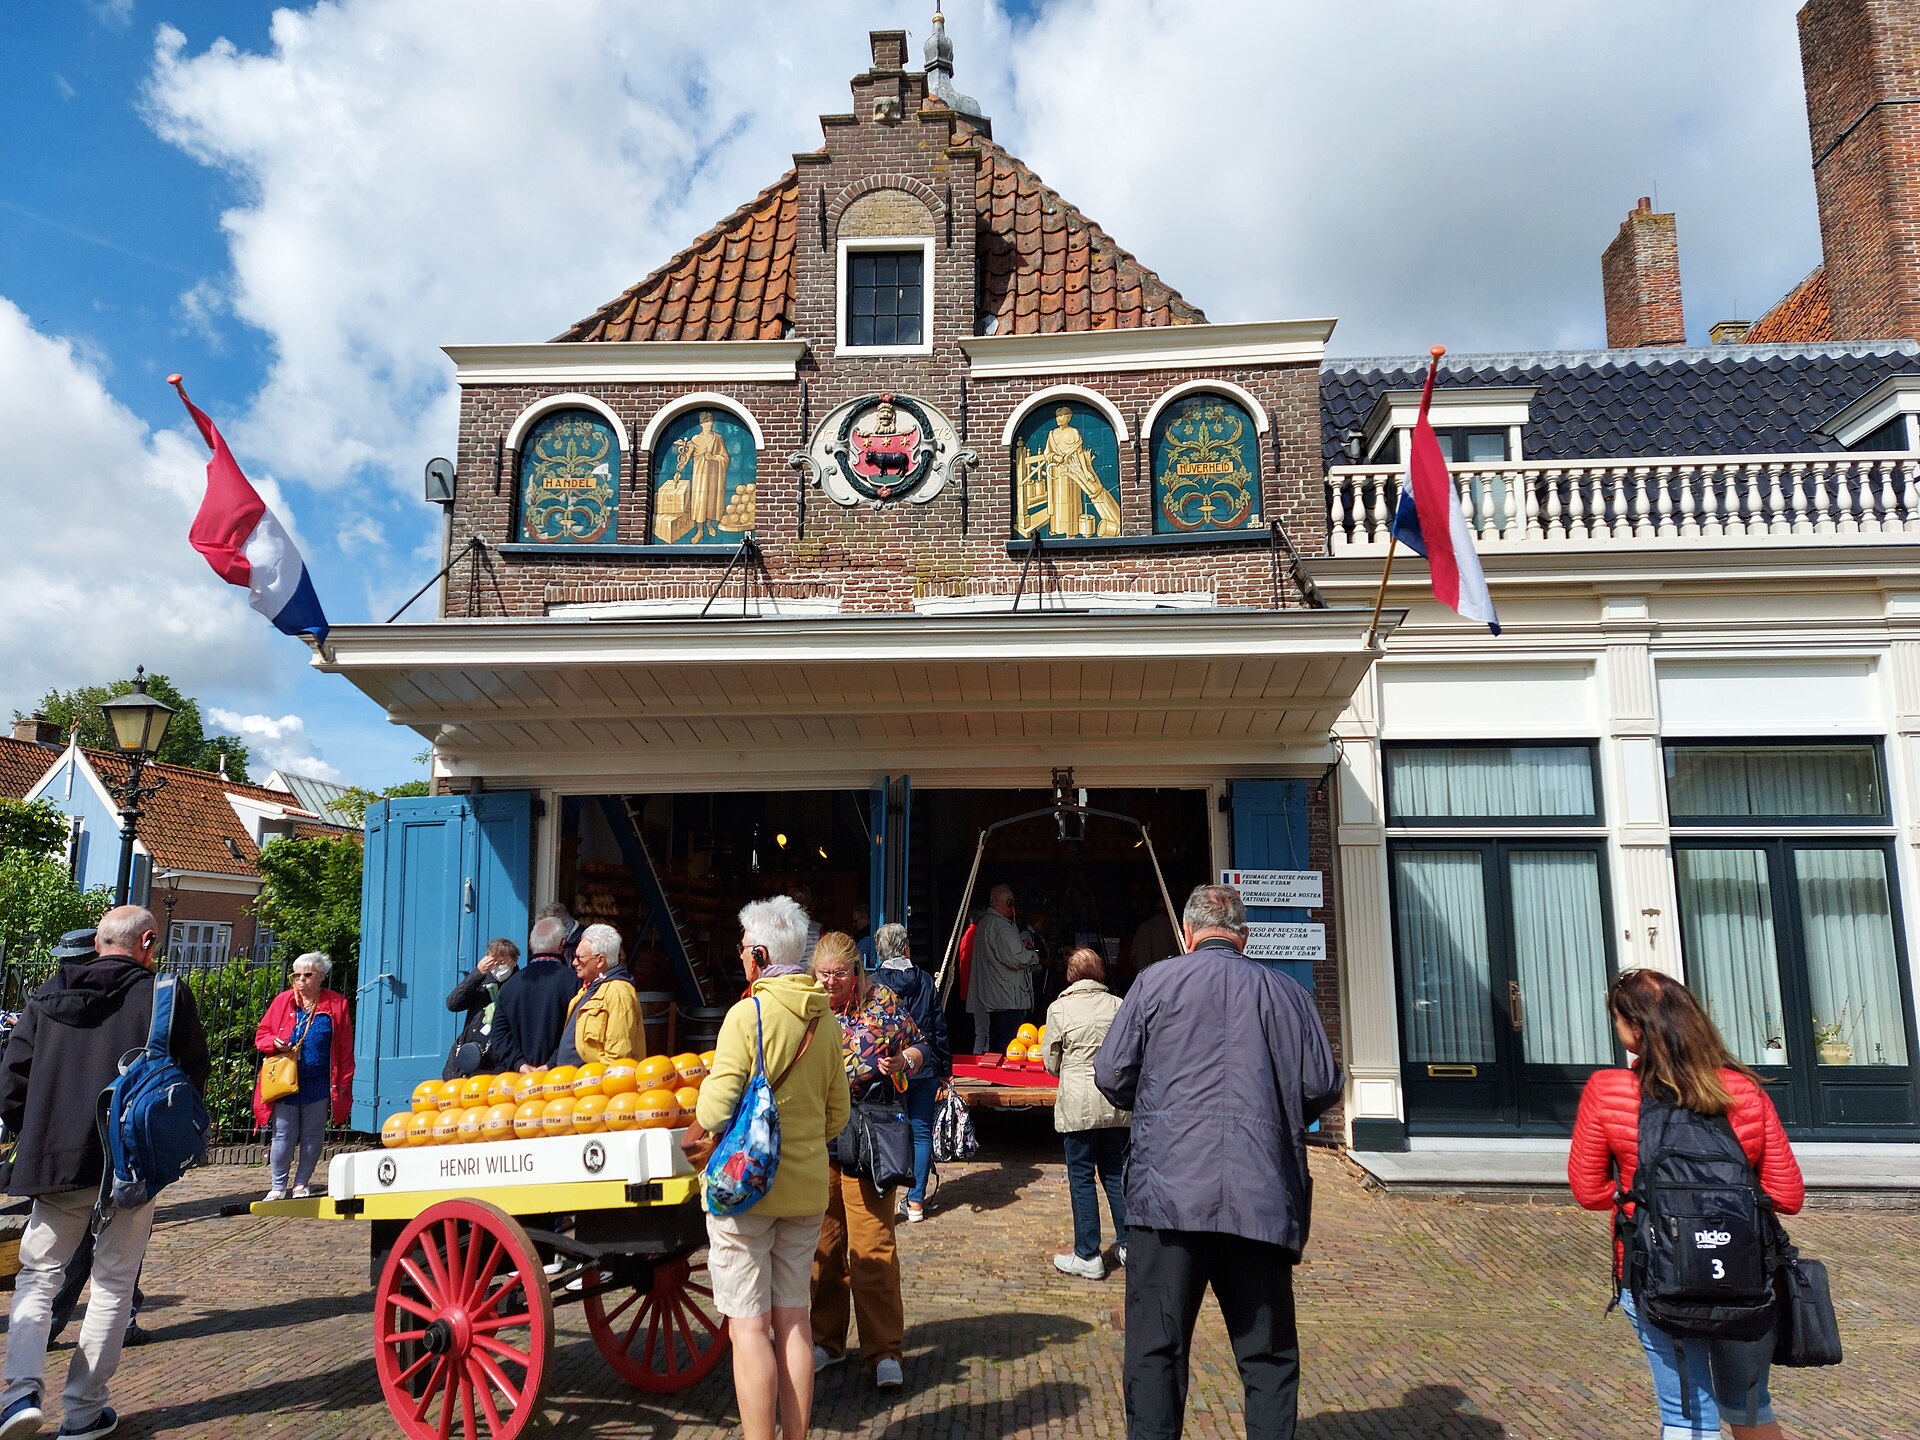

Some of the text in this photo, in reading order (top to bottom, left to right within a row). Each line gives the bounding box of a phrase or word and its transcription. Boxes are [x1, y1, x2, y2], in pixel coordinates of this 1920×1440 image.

[545, 478, 593, 488] HANDEL
[686, 1068, 702, 1076] EDAM
[553, 1084, 571, 1092] EDAM
[440, 1153, 534, 1177] HENRI WILLIG
[1694, 1230, 1732, 1242] nicko
[1711, 1258, 1725, 1280] 3
